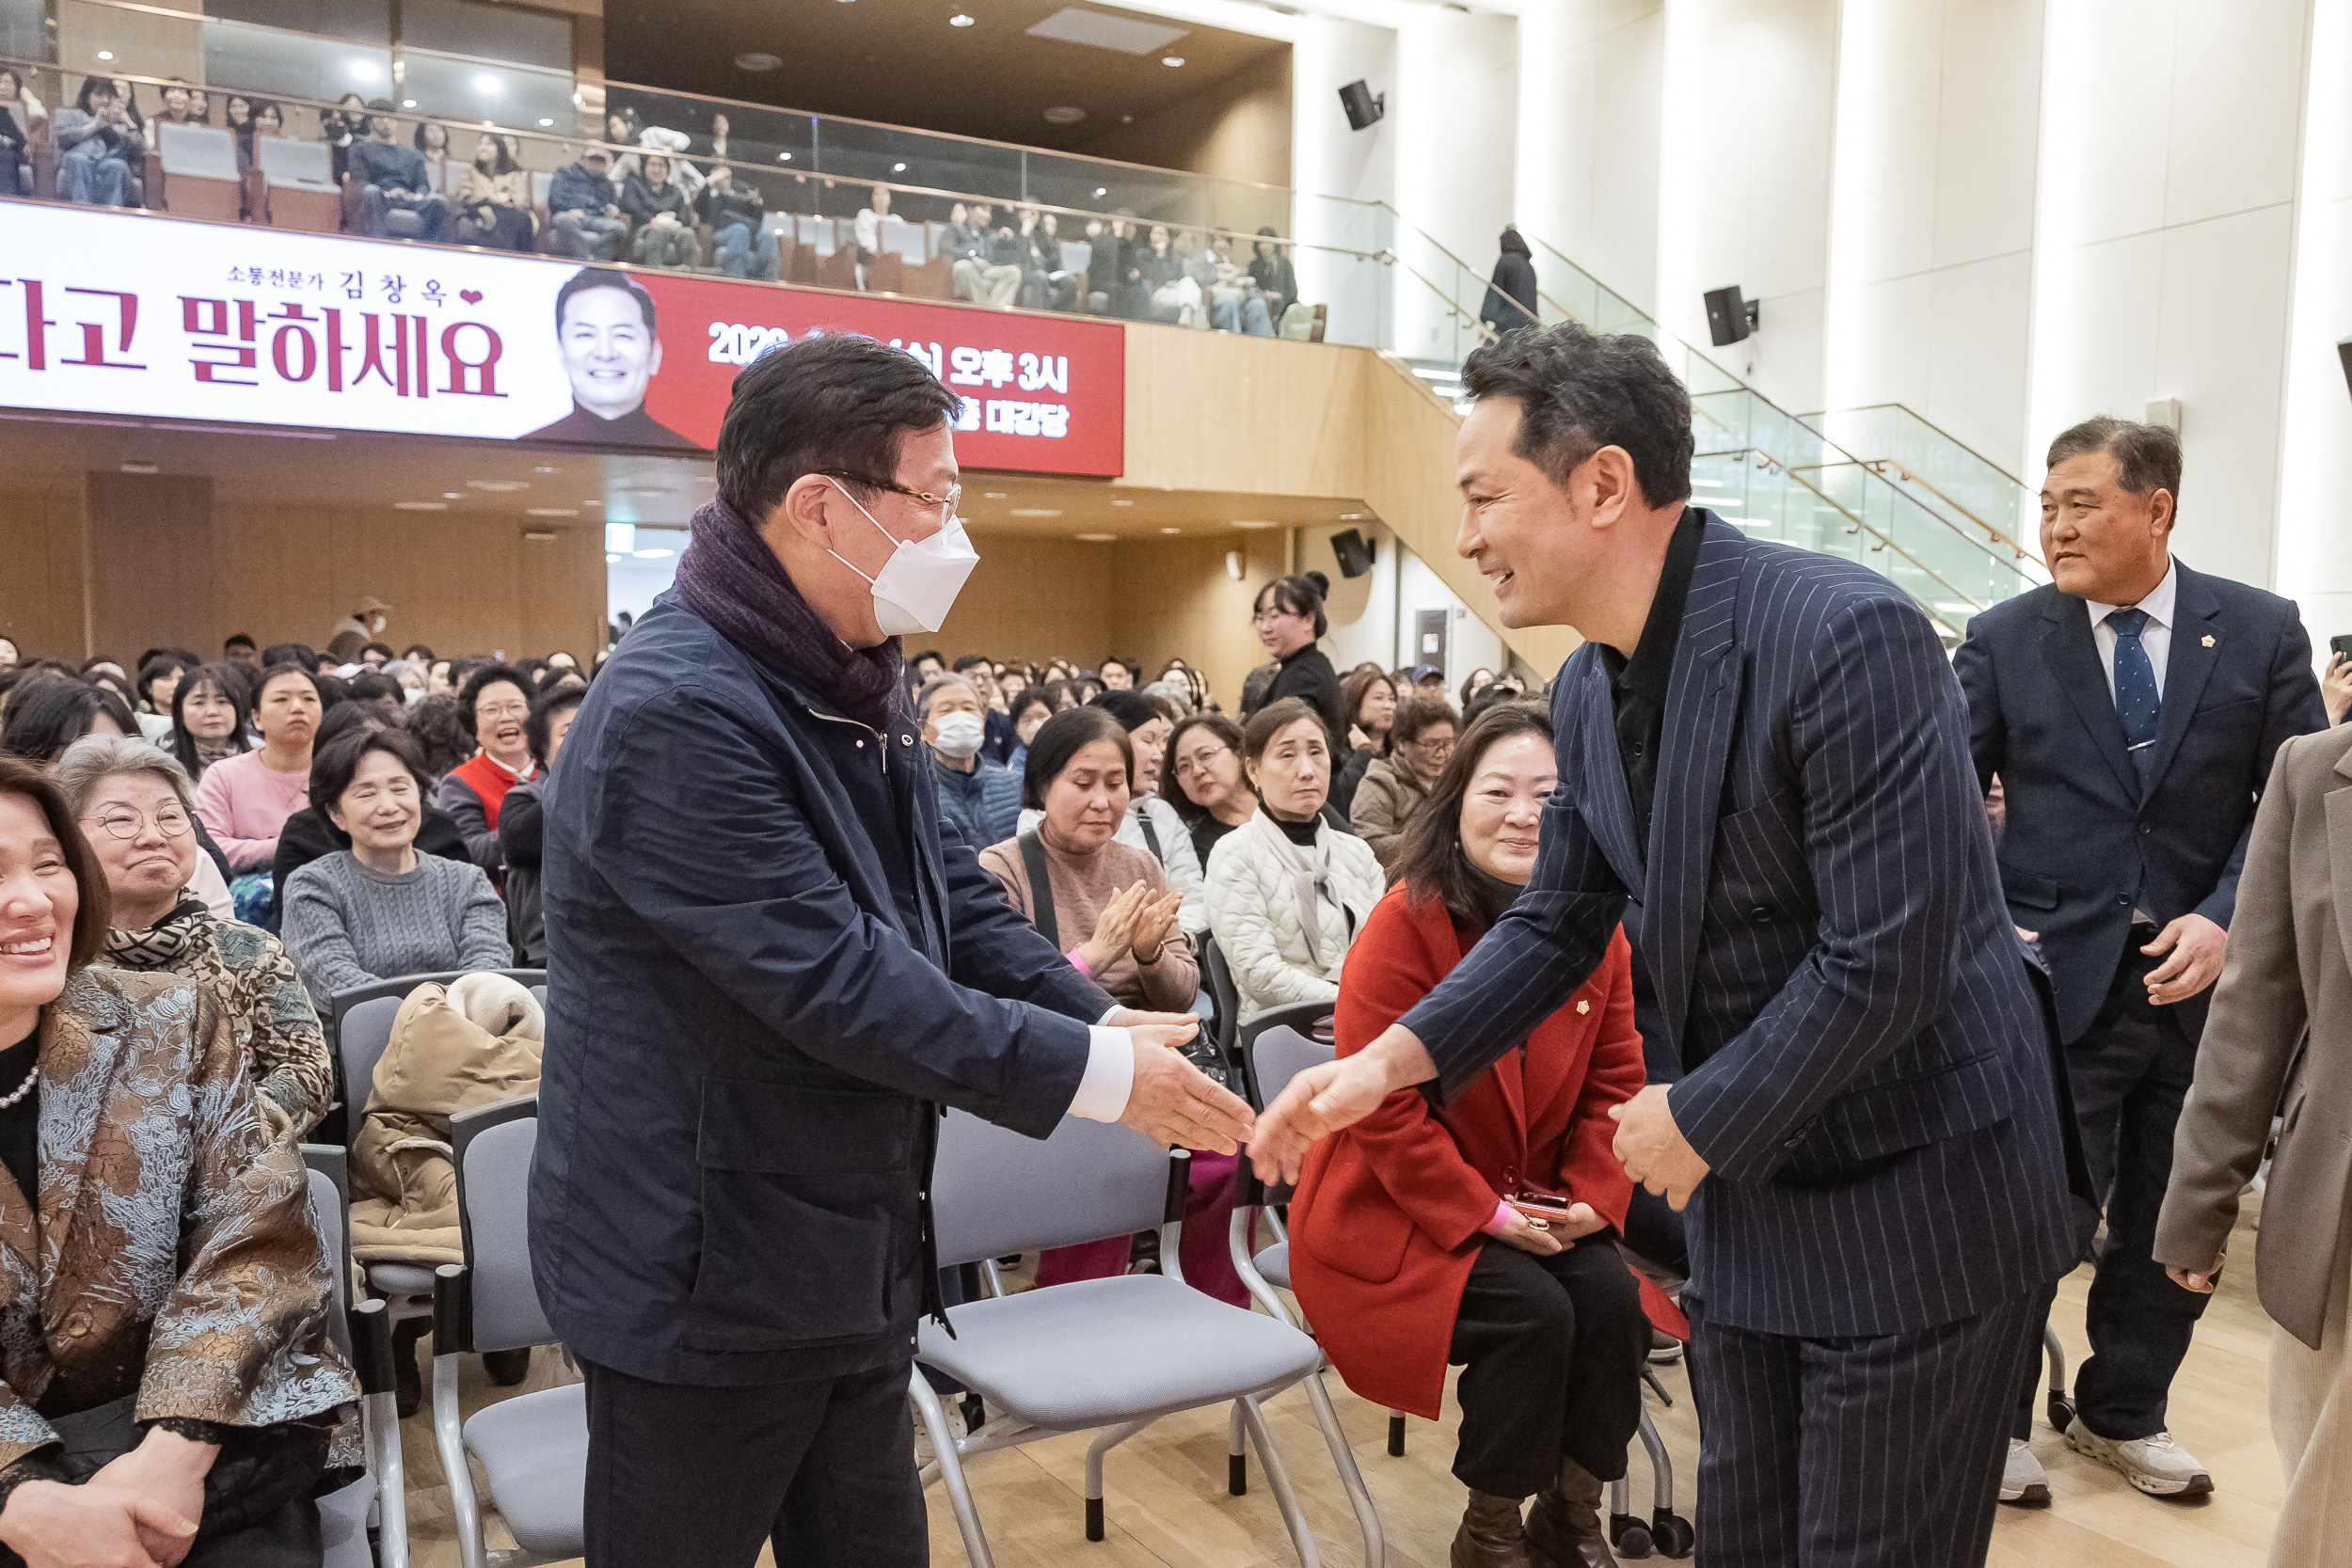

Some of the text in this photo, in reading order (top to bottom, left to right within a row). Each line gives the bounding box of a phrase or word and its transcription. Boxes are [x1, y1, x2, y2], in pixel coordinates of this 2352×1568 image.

[228, 266, 324, 291] 소통전문가
[177, 295, 508, 398] 말하세요
[949, 346, 1014, 388] 오후
[1017, 352, 1068, 394] 3시
[985, 399, 1071, 438] 대강당
